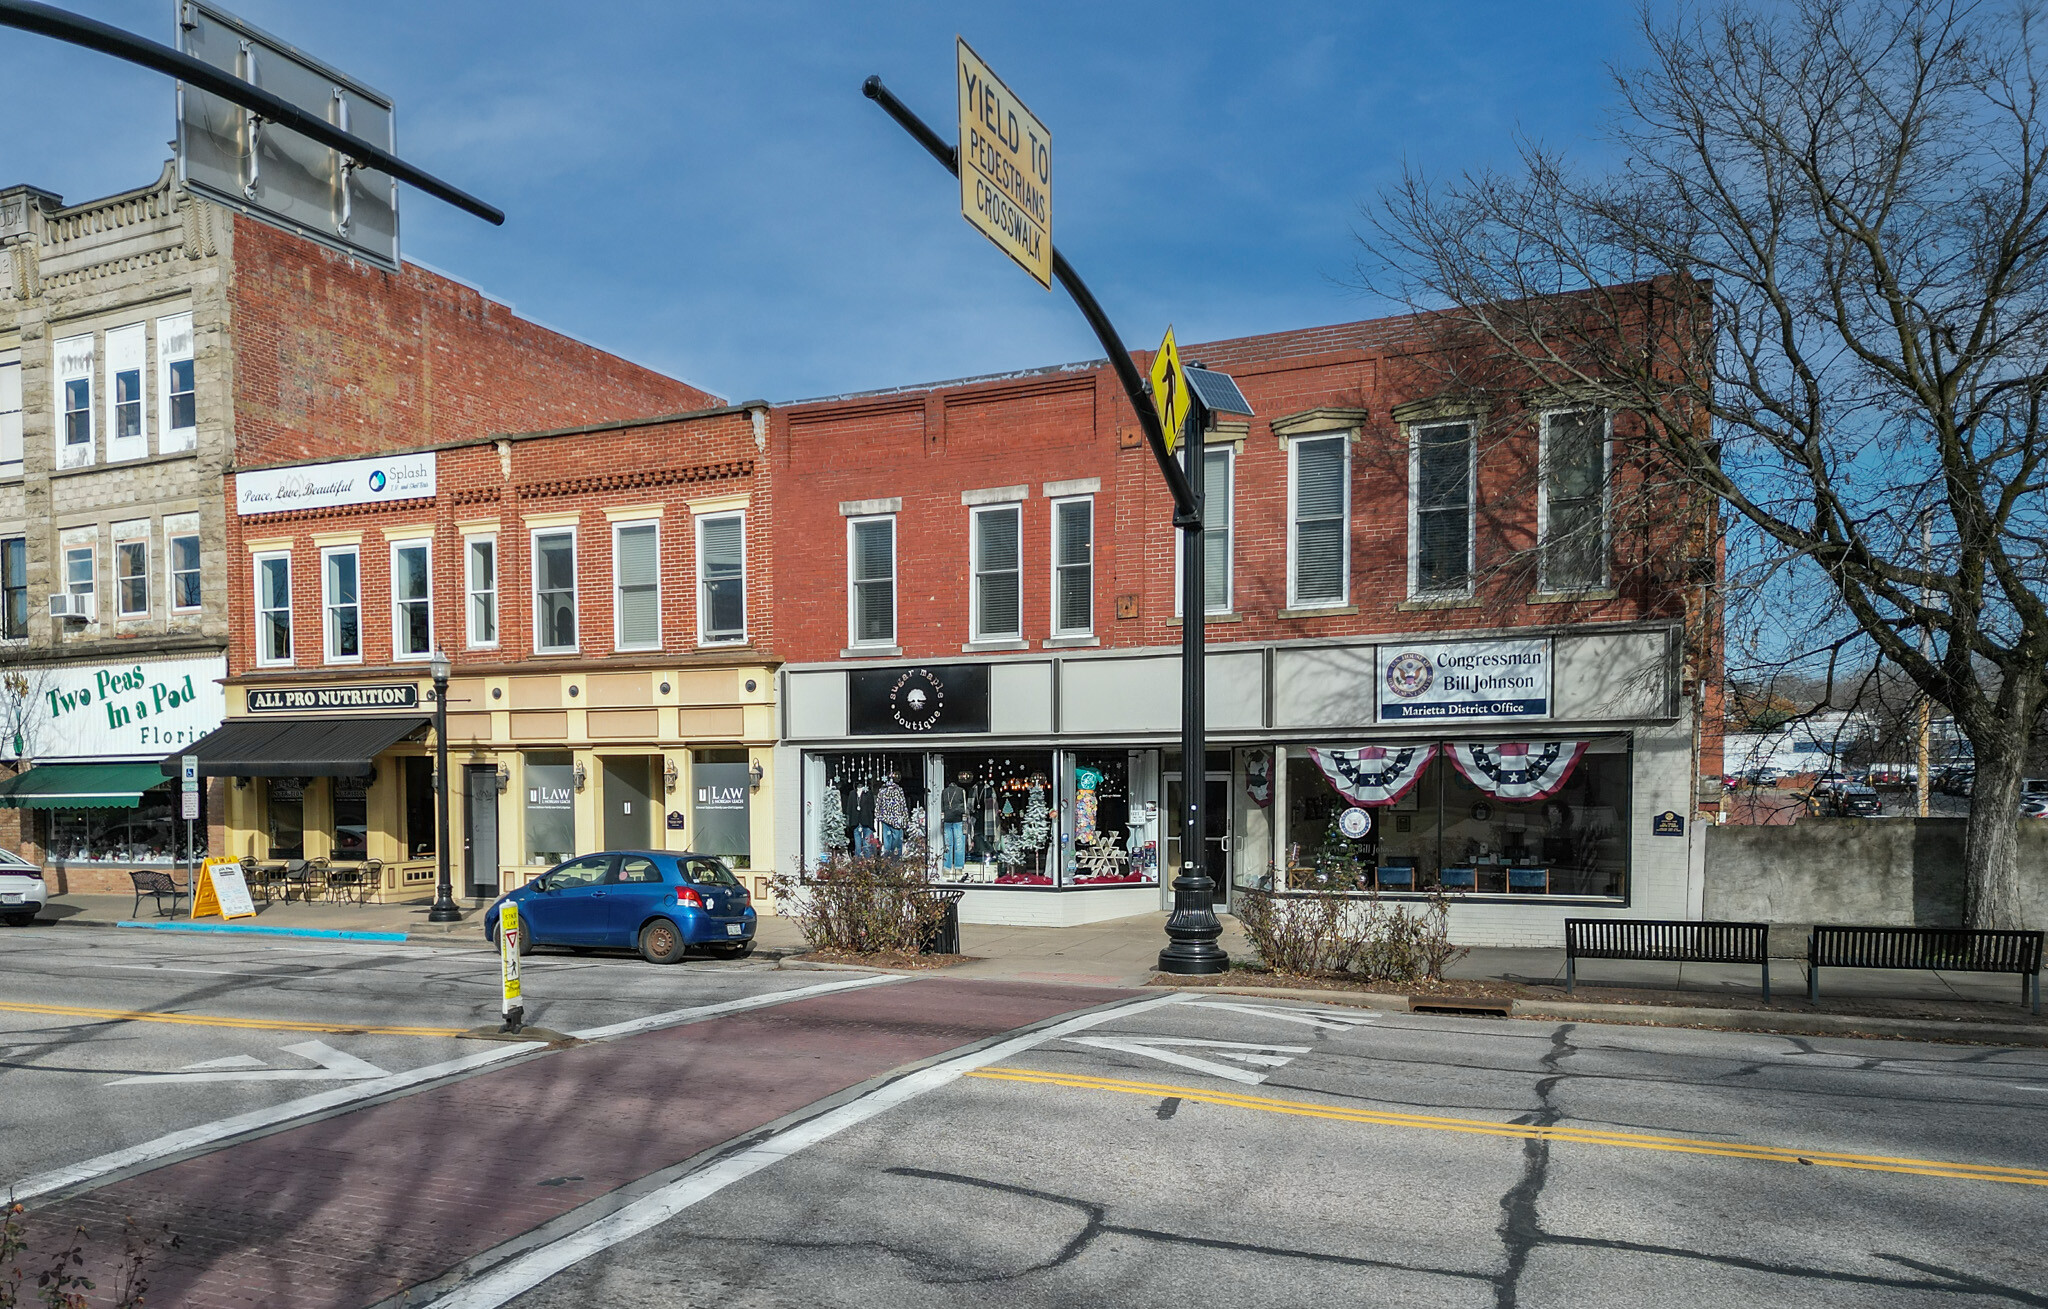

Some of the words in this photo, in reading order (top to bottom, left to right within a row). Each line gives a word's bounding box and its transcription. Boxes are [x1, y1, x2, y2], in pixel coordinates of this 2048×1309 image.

[962, 62, 1019, 155] YIELD
[1027, 127, 1048, 185] TO
[970, 127, 1045, 224] PEDESTRIANS
[976, 179, 1041, 263] CROSSWALK
[389, 463, 428, 484] Splash
[242, 489, 273, 503] Peace,
[275, 485, 301, 500] Love,
[302, 478, 355, 497] Beautiful
[1437, 652, 1541, 671] Congressman
[45, 685, 92, 718] Two
[93, 664, 145, 701] Peas
[889, 669, 914, 700] sugar
[919, 669, 944, 699] maple
[1444, 675, 1470, 691] Bill
[1471, 675, 1534, 694] Johnson
[105, 701, 131, 730] In
[135, 700, 148, 720] a
[148, 674, 196, 716] Pod
[255, 692, 284, 708] ALL
[285, 691, 315, 707] PRO
[318, 688, 406, 705] NUTRITION
[1402, 704, 1446, 716] Marietta
[1448, 704, 1488, 715] District
[1490, 702, 1524, 714] Office
[893, 710, 941, 731] boutique
[140, 726, 216, 745] Floris
[541, 787, 570, 800] LAW
[711, 786, 744, 800] LAW
